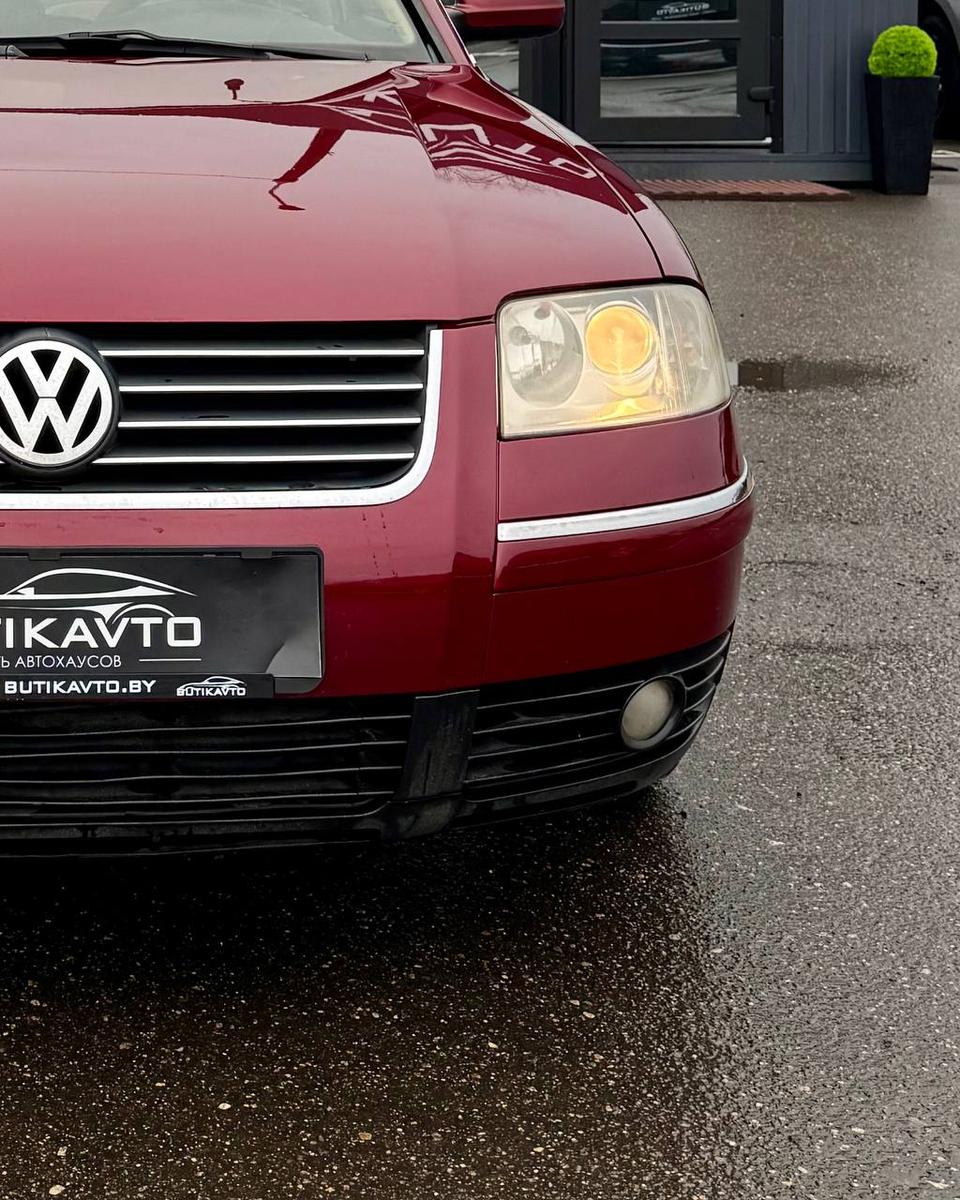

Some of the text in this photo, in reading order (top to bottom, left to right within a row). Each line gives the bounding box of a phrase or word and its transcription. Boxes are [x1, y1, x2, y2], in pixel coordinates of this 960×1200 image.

[15, 654, 122, 669] АВТОХАУСОВ
[4, 679, 157, 695] BUTIKAVTO.BY
[176, 687, 247, 698] BUTIKAVTO
